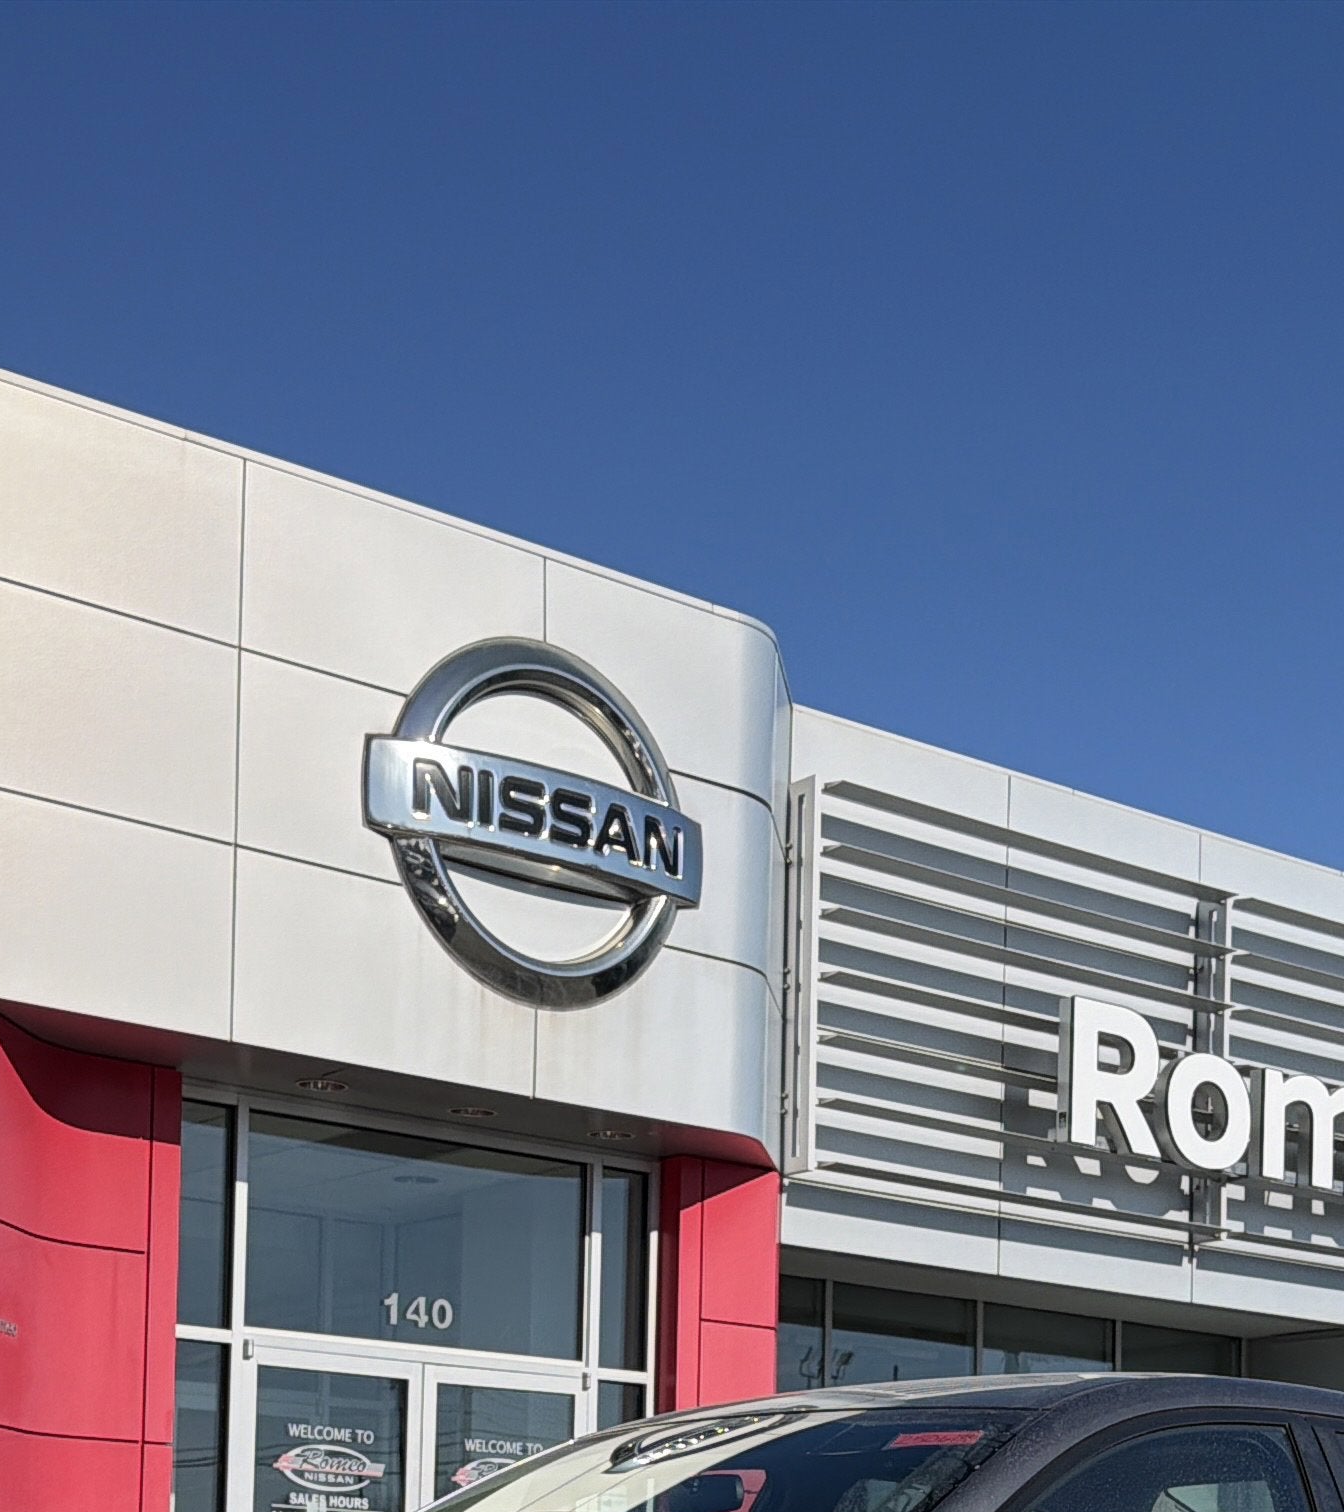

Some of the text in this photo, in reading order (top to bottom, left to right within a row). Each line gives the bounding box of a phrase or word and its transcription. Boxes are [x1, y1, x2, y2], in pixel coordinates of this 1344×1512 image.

[411, 757, 685, 881] NISSAN
[383, 1292, 453, 1330] 140
[288, 1423, 374, 1445] WELCOME TO
[464, 1438, 523, 1456] WELCOME
[295, 1447, 367, 1473] Romeo
[304, 1472, 354, 1485] NISSAN
[289, 1491, 369, 1509] SALES HOURS
